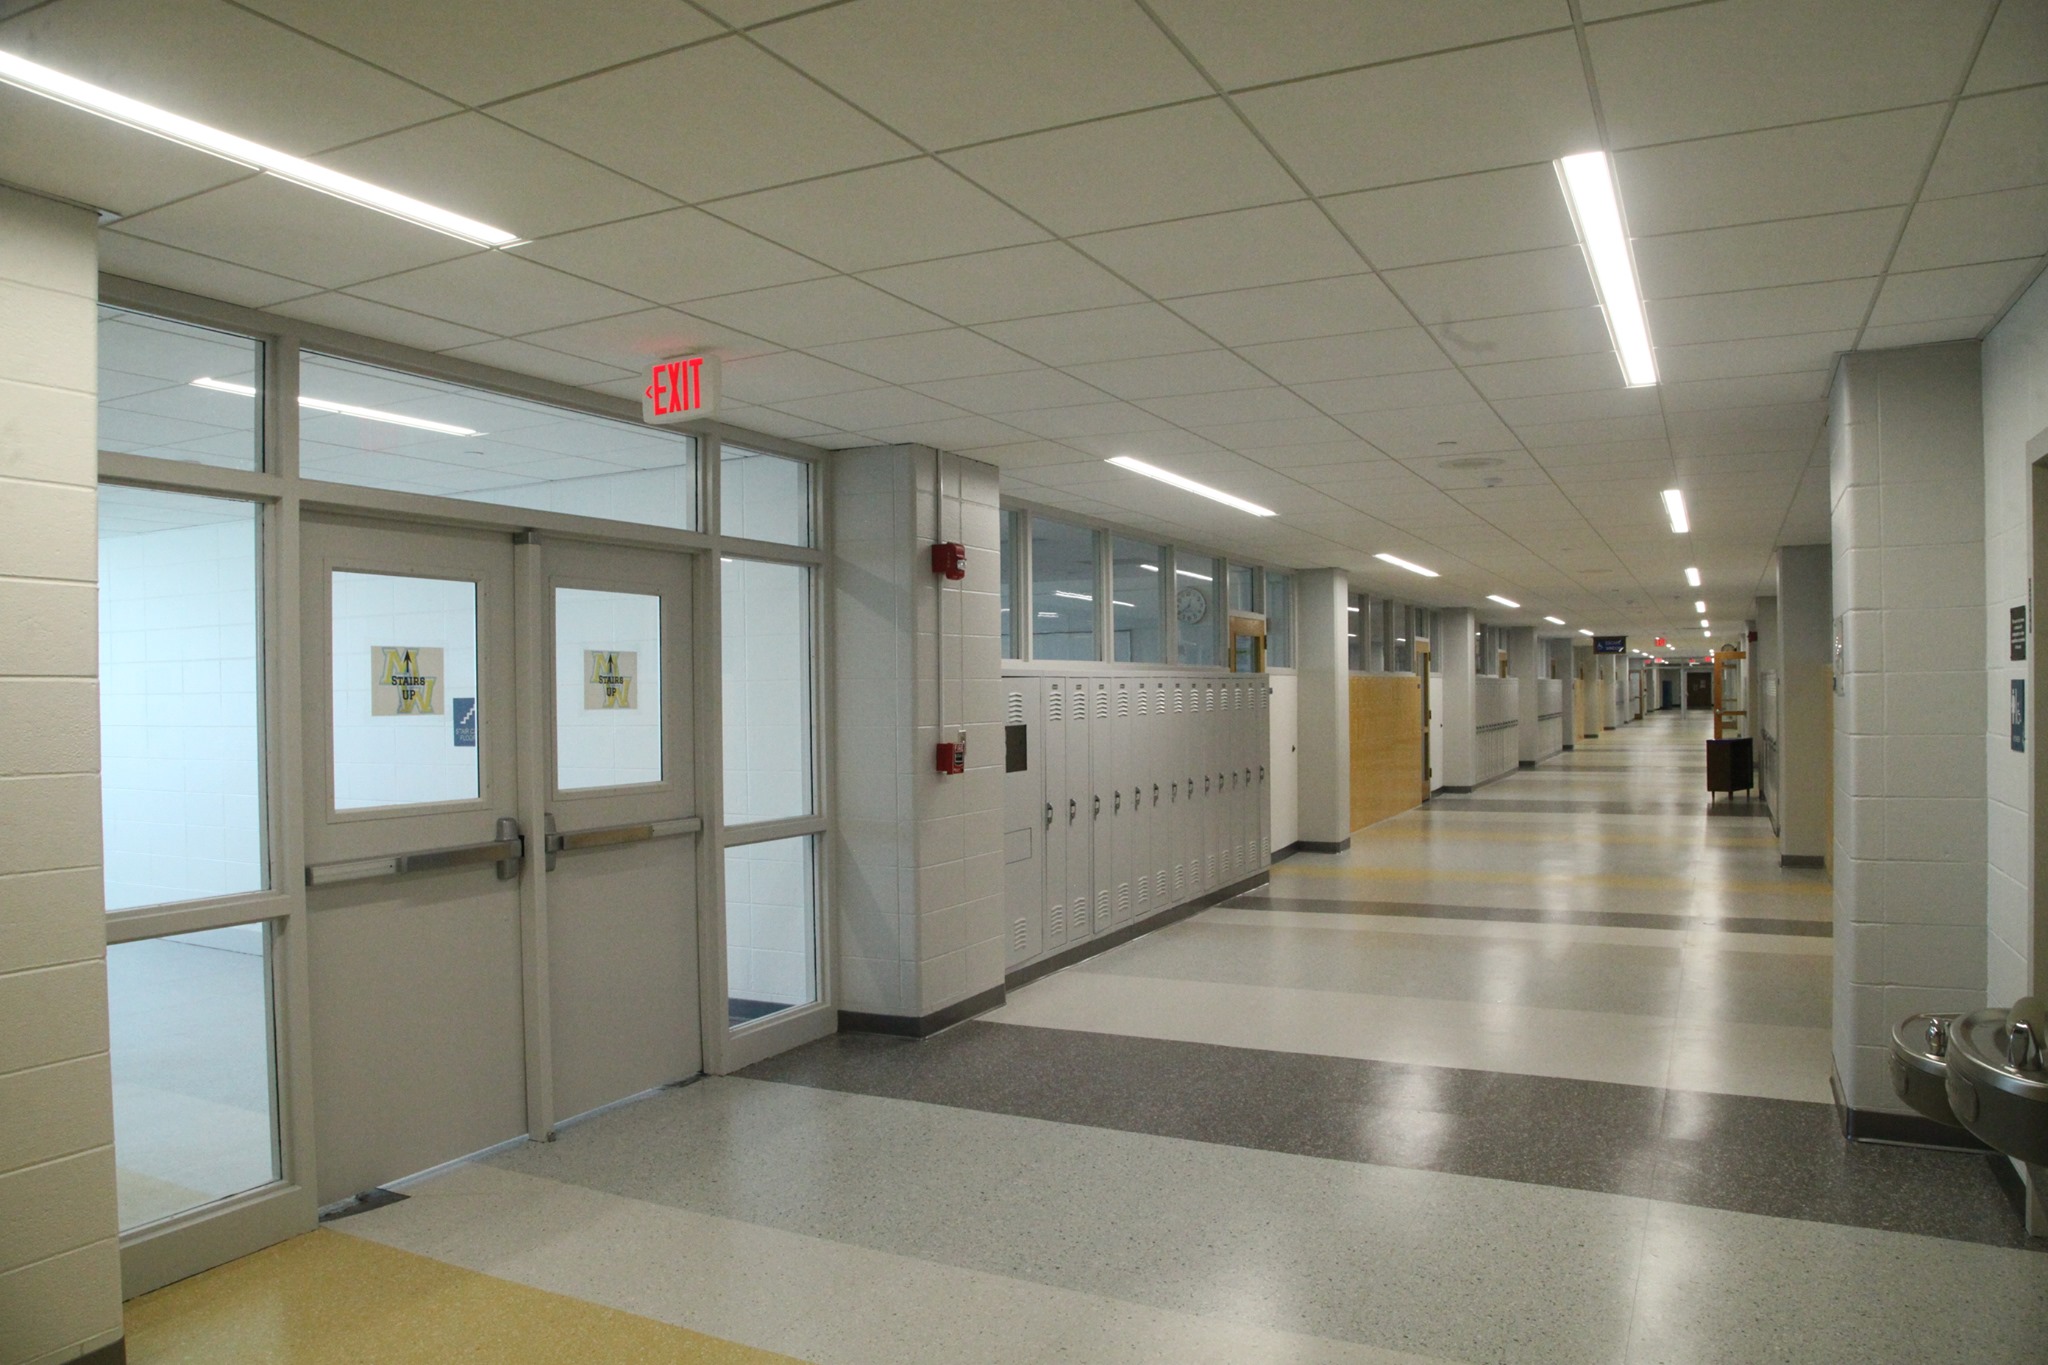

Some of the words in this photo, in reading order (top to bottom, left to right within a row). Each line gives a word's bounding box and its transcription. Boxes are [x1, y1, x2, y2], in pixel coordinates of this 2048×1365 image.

[654, 358, 703, 415] EXIT
[391, 675, 425, 686] STAIRS
[598, 675, 623, 684] STAIRS
[402, 689, 416, 700] UP
[606, 688, 616, 696] UP
